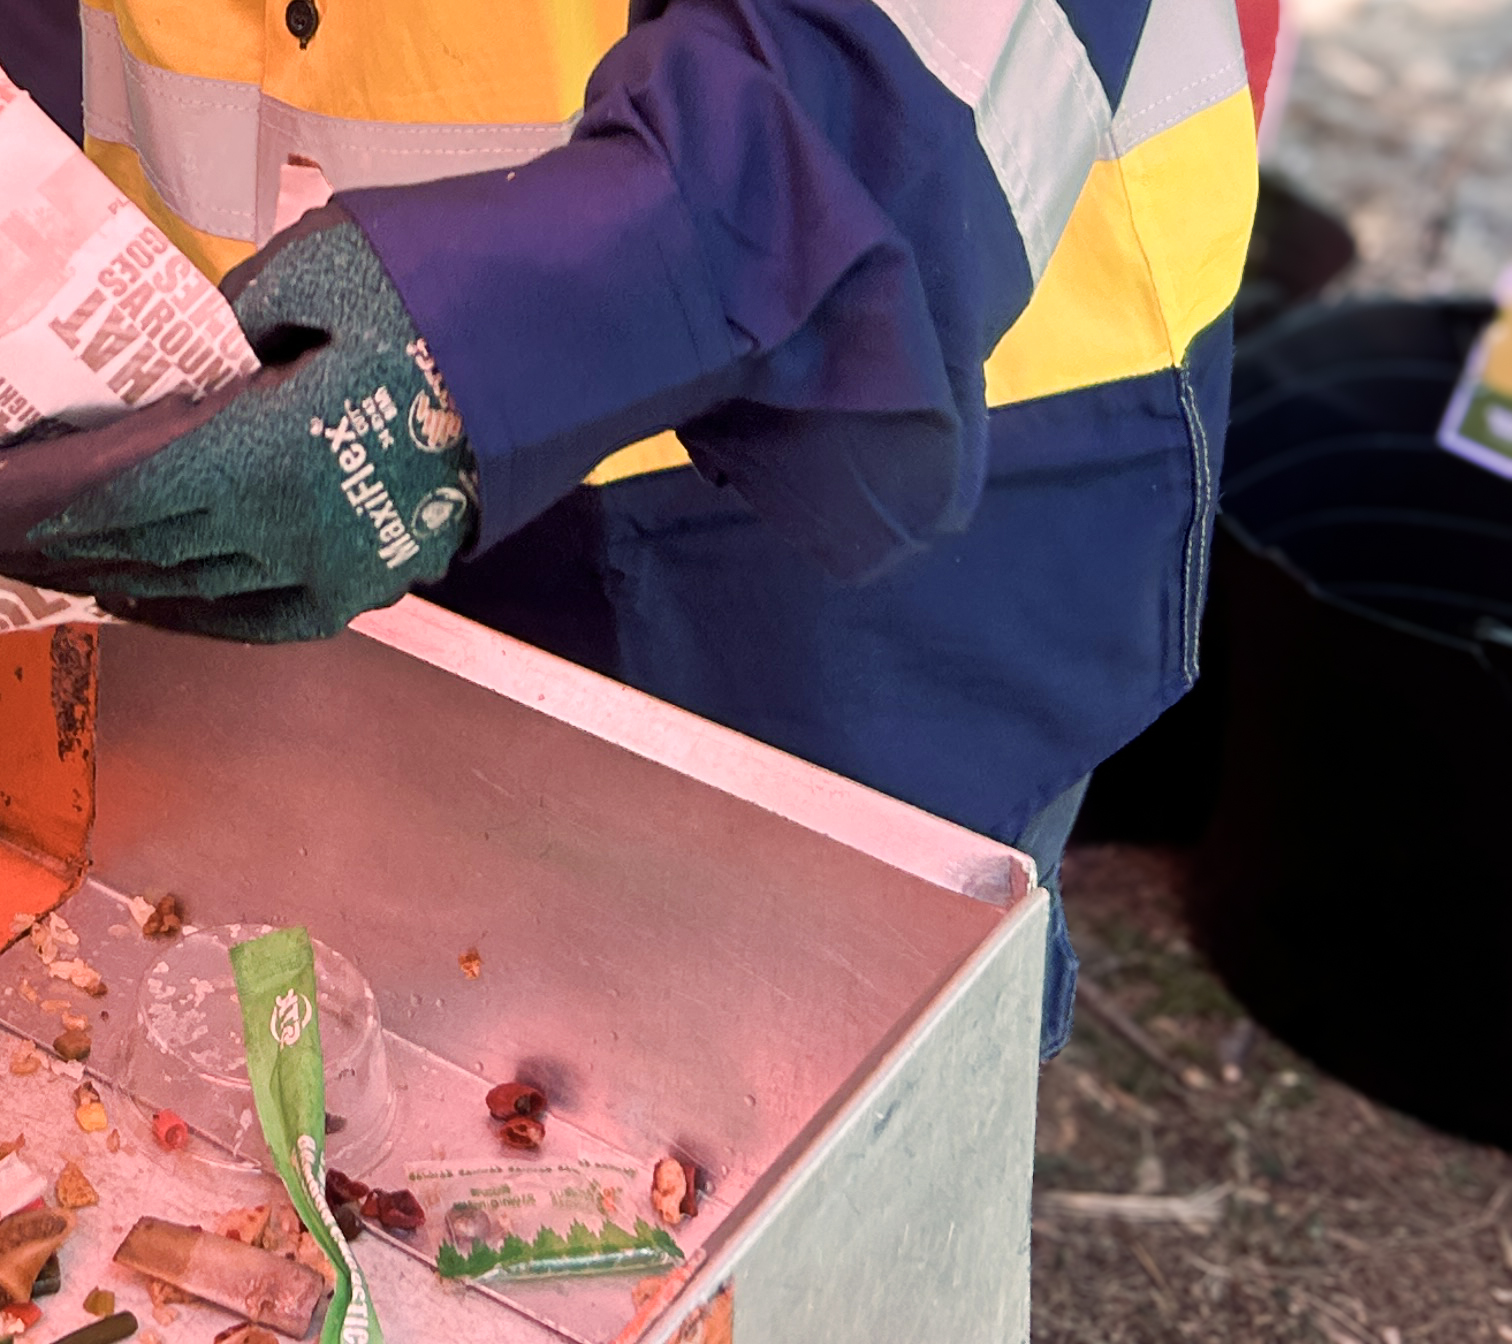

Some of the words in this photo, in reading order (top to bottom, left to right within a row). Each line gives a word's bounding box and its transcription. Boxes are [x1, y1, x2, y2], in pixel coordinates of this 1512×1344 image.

[97, 226, 170, 298] GOES
[48, 286, 178, 406] HAT
[116, 280, 235, 392] AROUN
[324, 415, 420, 570] MaxiFlex
